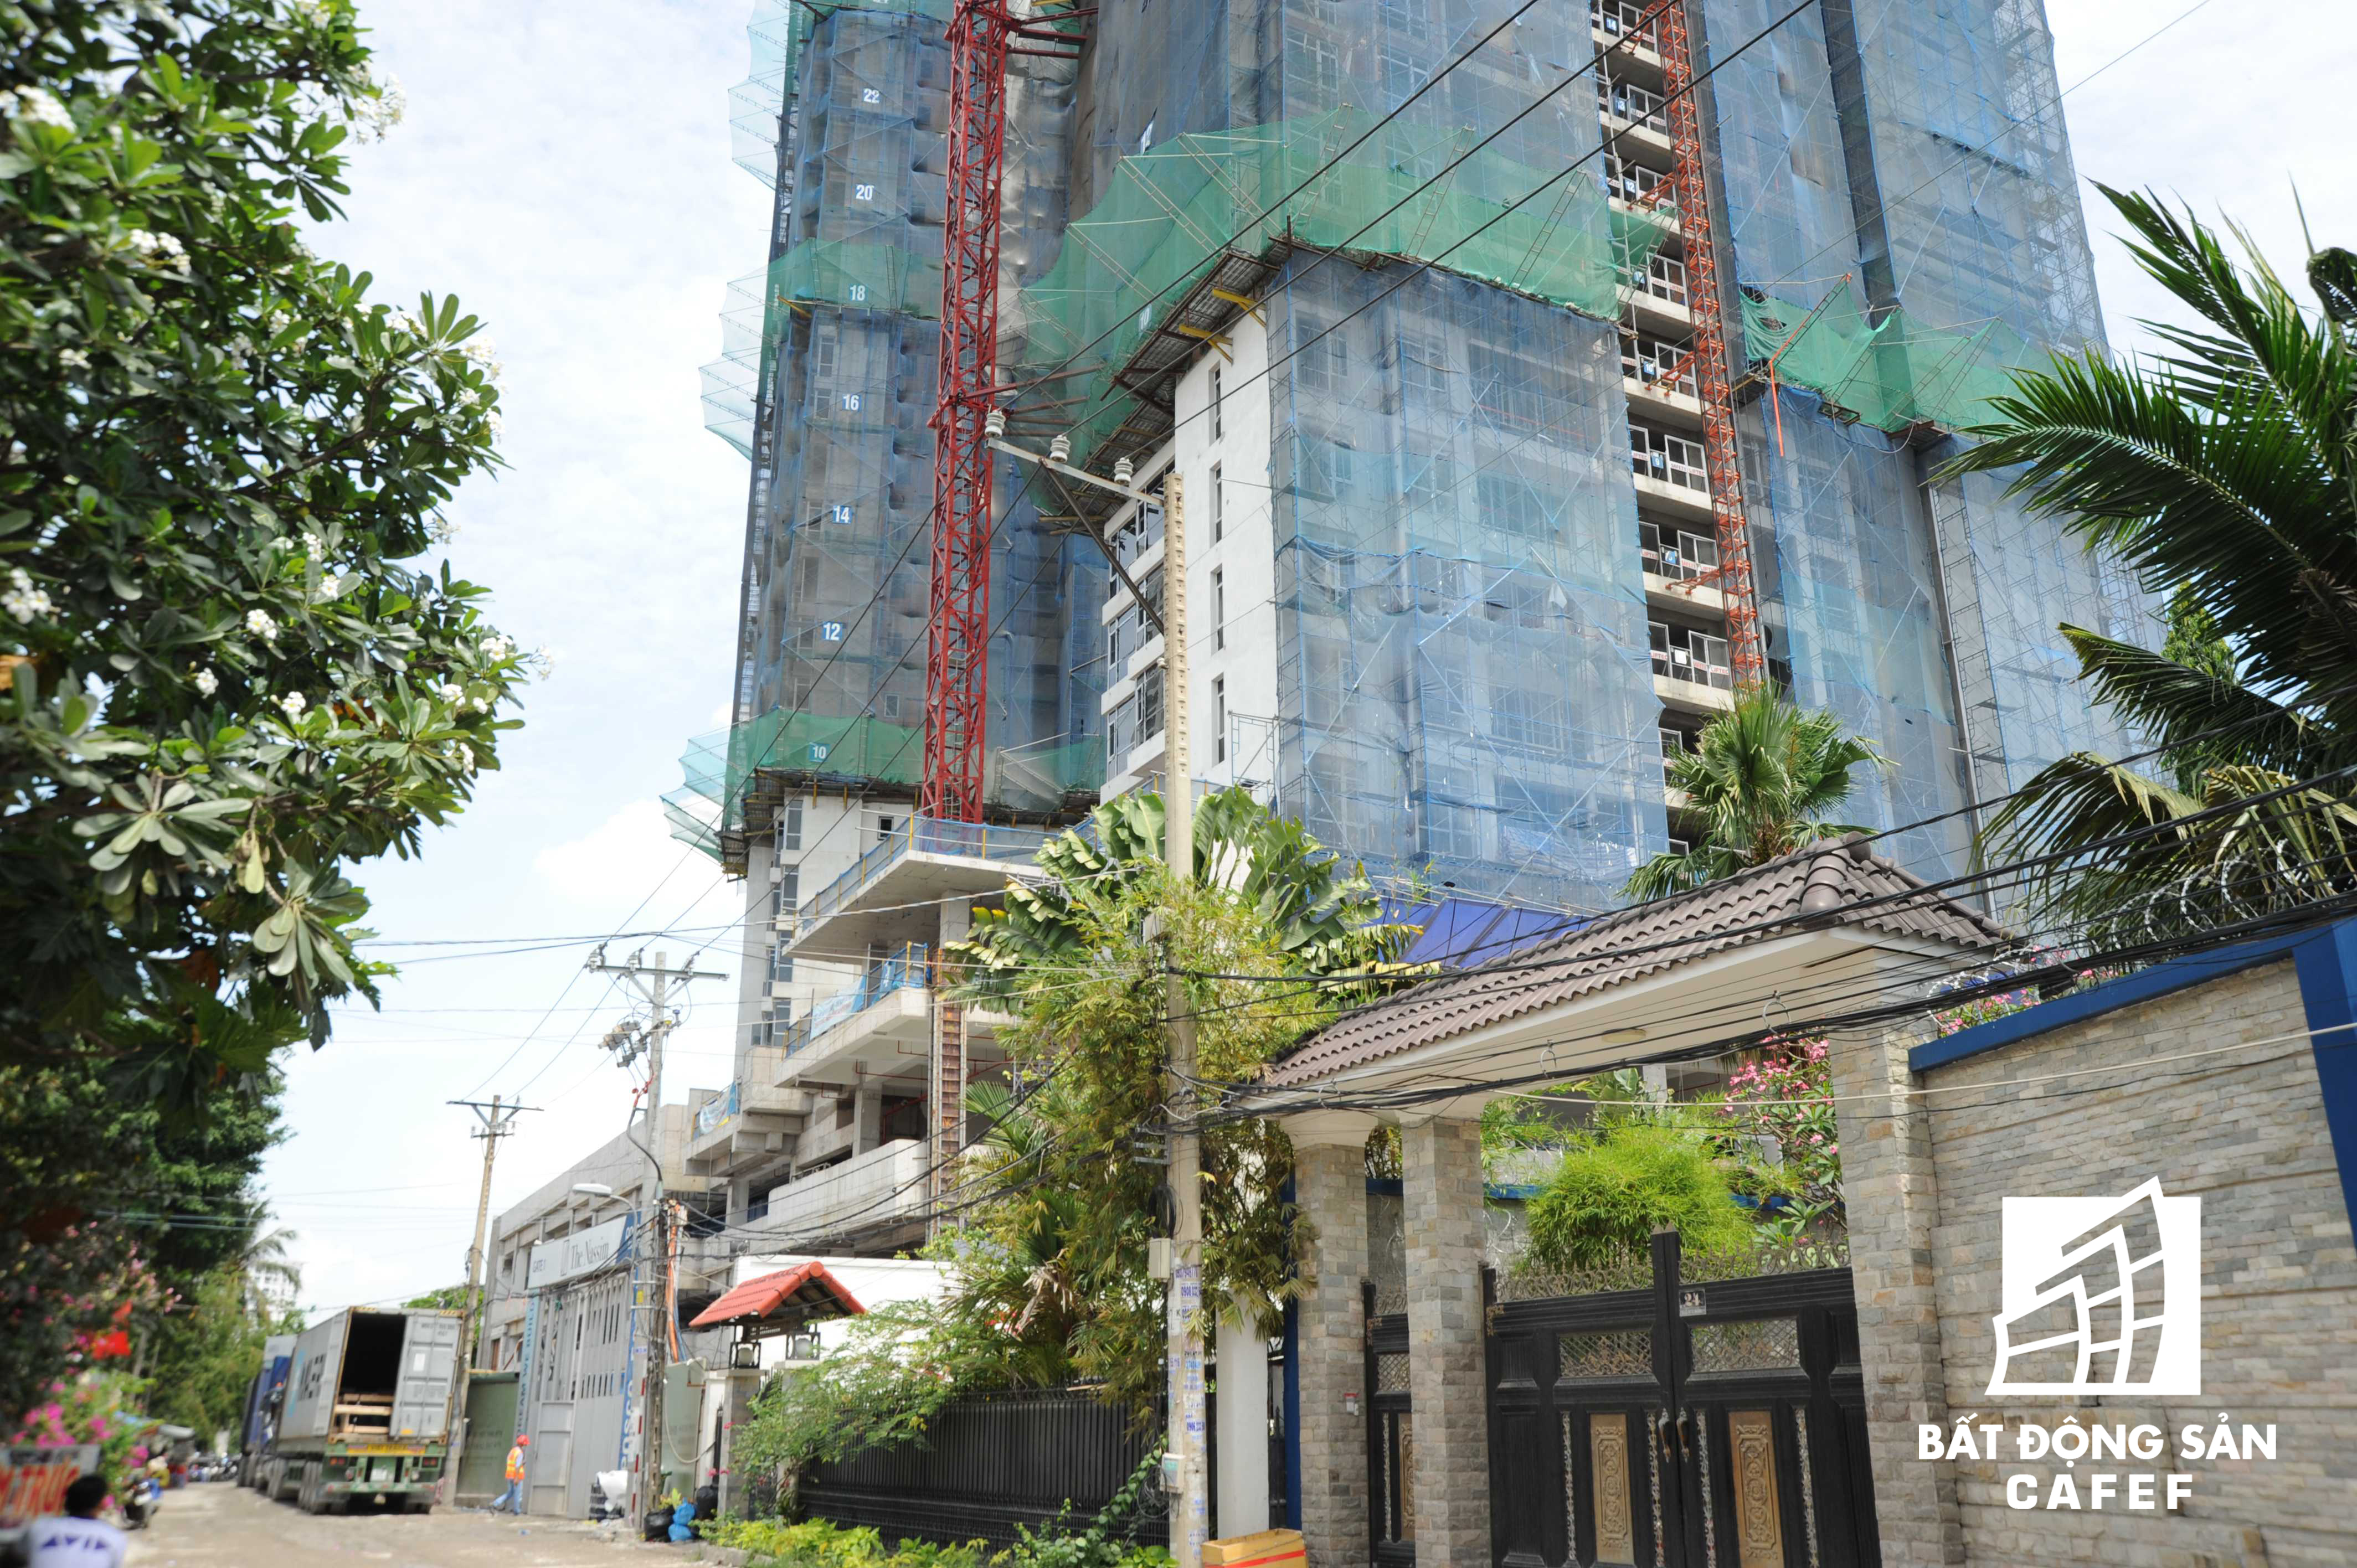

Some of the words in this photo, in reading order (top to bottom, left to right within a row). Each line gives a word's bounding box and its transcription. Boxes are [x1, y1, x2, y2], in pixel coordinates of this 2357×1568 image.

[1607, 18, 1617, 31] 14
[864, 88, 879, 104] 22
[856, 184, 874, 200] 20
[1625, 180, 1635, 193] 12
[850, 285, 865, 301] 18
[843, 394, 860, 411] 16
[833, 505, 850, 523] 14
[823, 622, 841, 641] 12
[812, 746, 826, 759] 10
